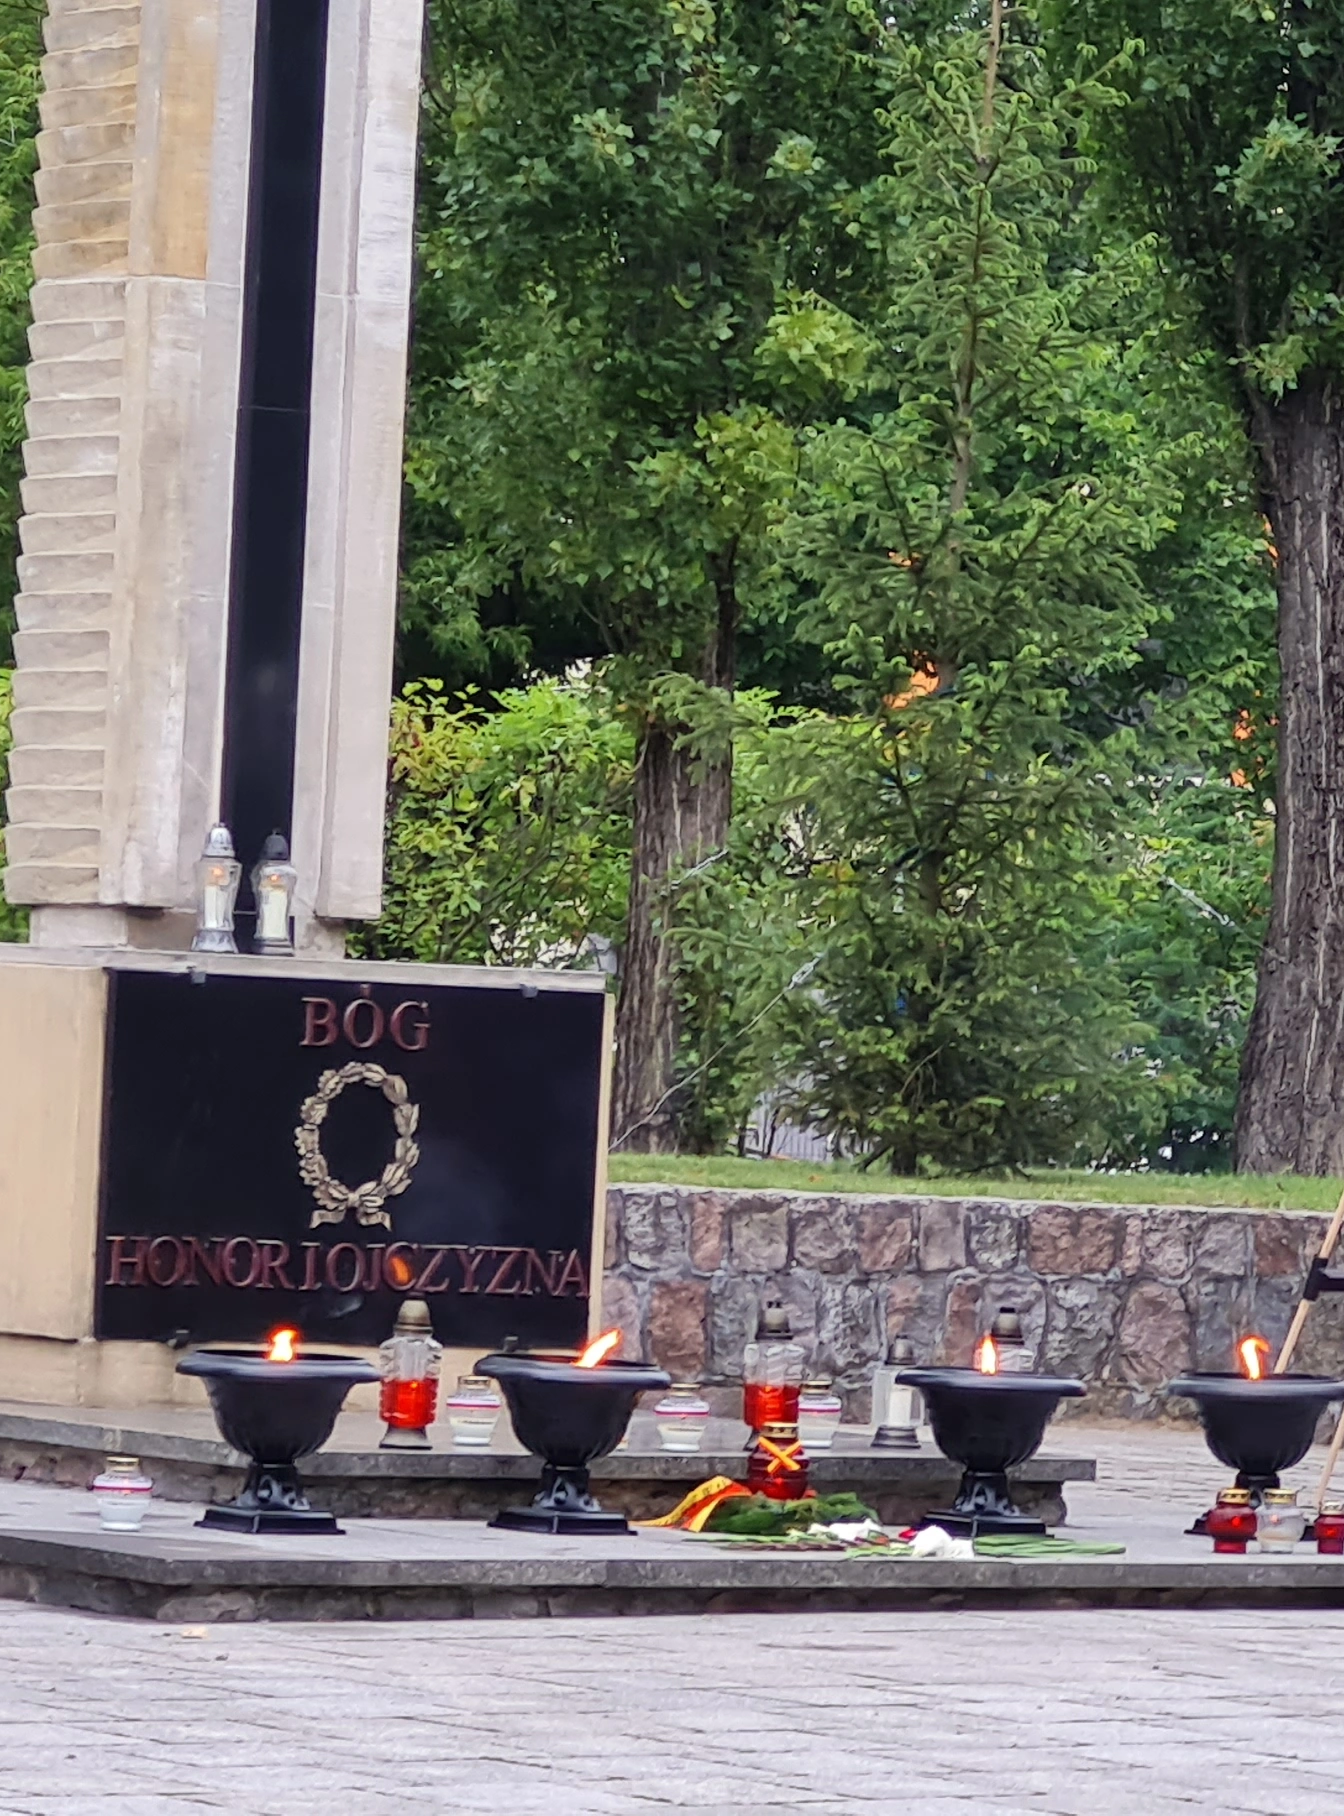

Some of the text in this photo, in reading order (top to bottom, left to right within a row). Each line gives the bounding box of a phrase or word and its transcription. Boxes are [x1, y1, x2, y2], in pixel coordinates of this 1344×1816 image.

[300, 984, 431, 1051] BÓG
[105, 1236, 591, 1299] HONOR I OJCZYZNA
